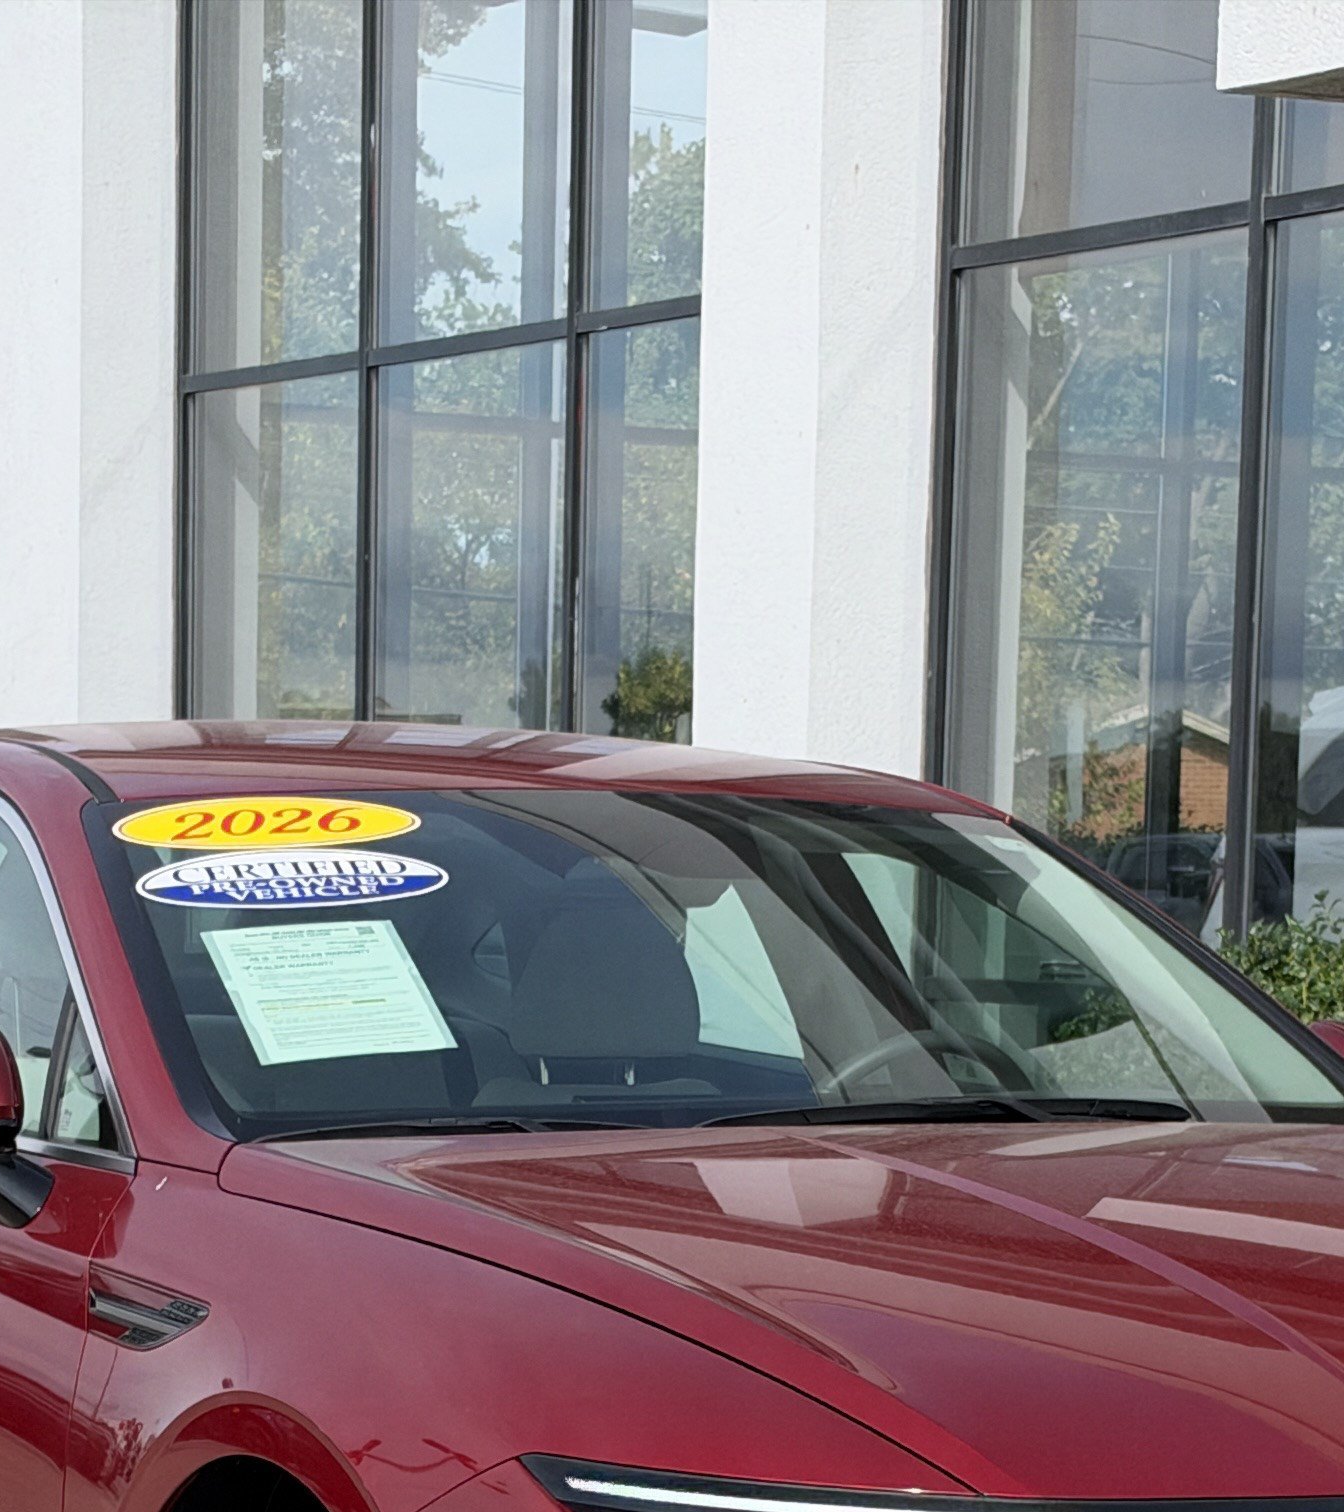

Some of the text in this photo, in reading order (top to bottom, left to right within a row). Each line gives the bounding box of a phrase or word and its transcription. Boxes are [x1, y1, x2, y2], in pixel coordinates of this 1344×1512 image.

[170, 807, 364, 841] 2026
[172, 860, 407, 885] CERTIFIED
[188, 875, 405, 896] PRE-OWNED
[226, 883, 380, 902] VEHICLE
